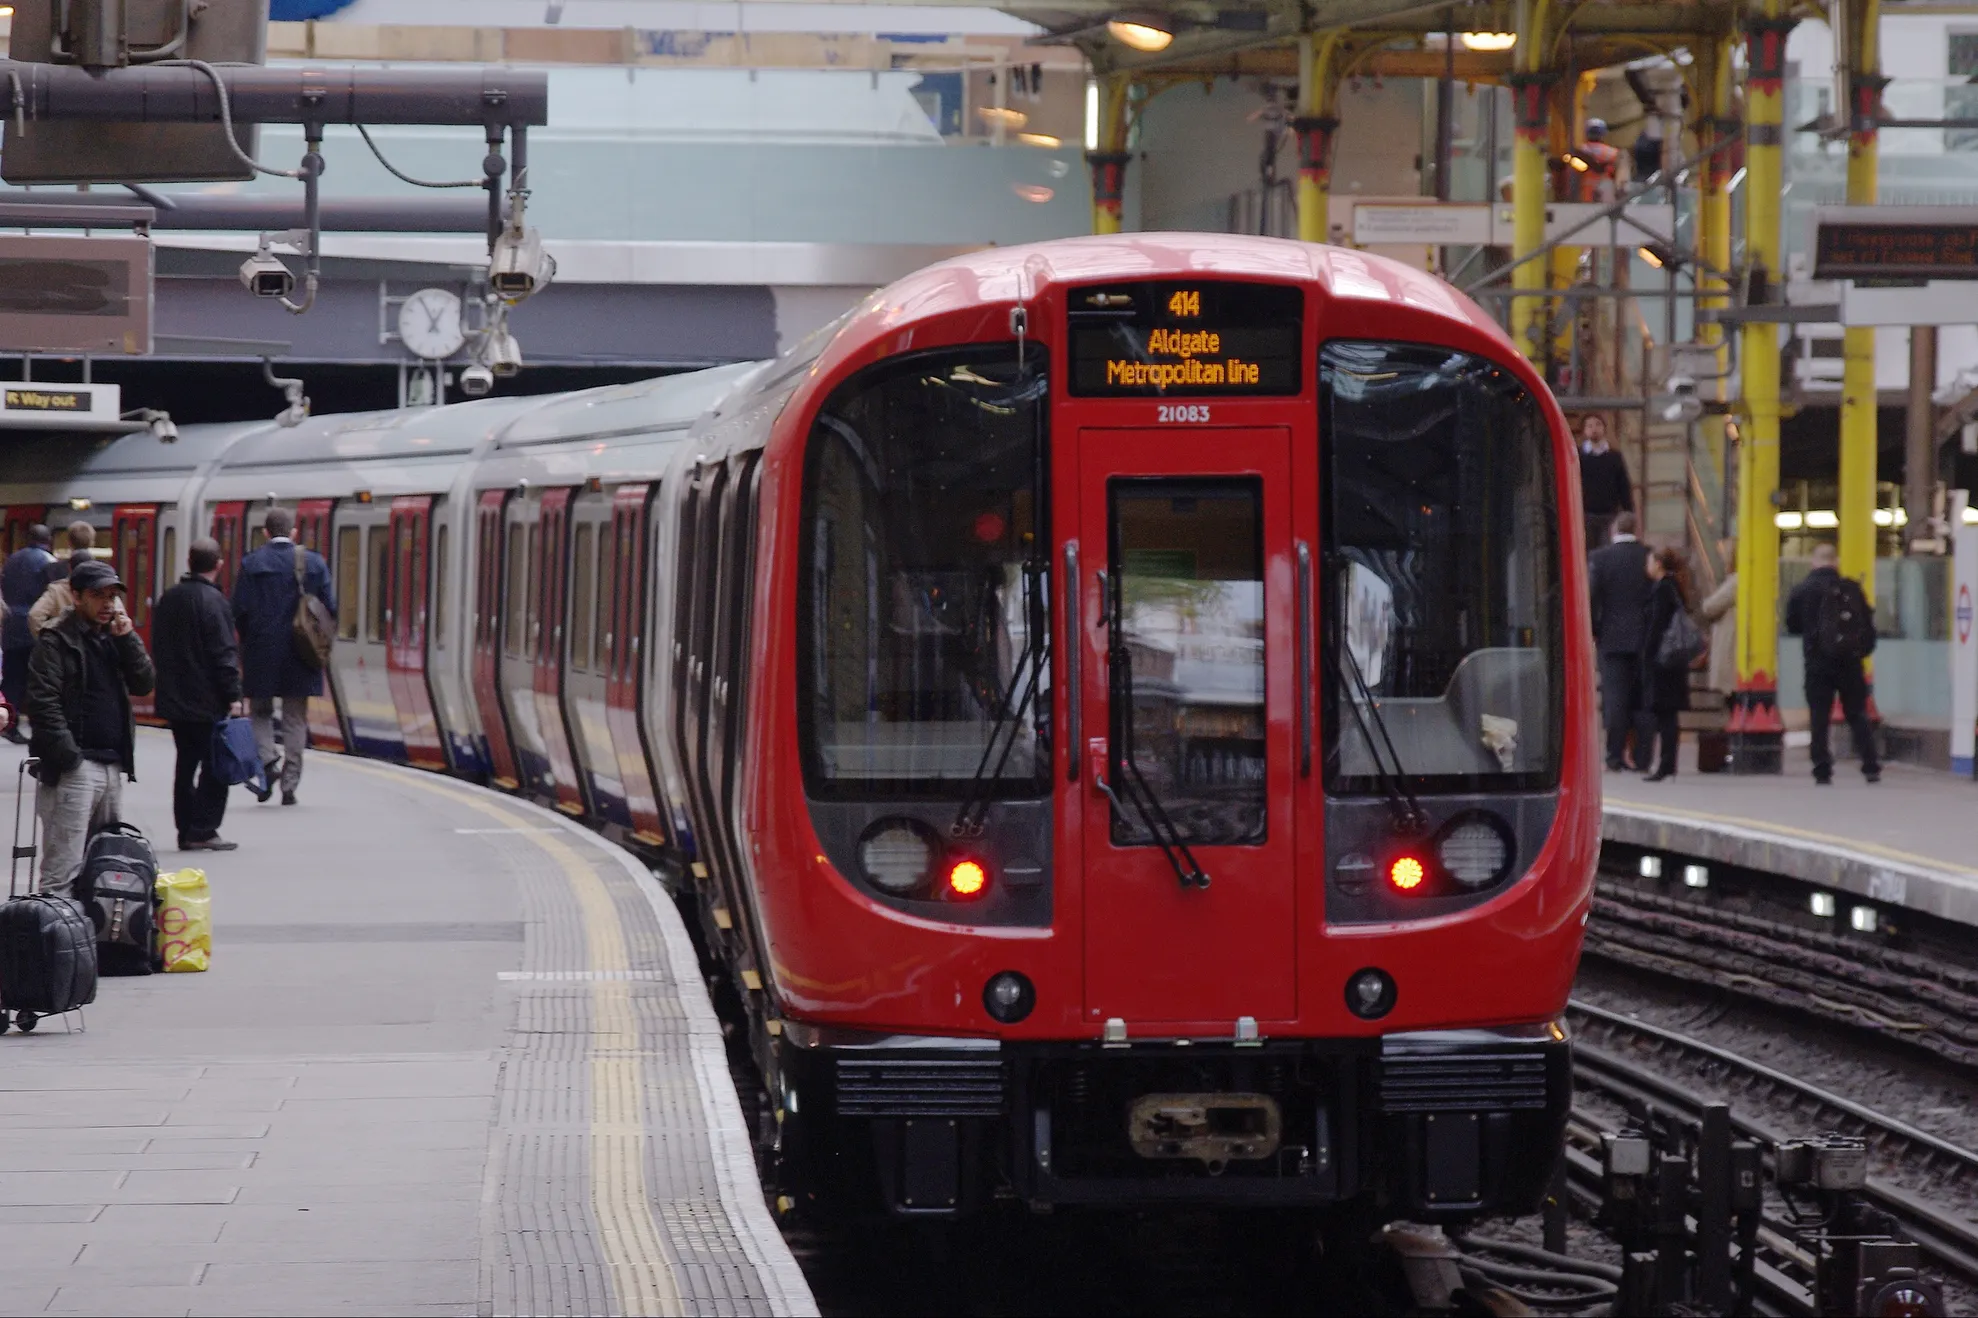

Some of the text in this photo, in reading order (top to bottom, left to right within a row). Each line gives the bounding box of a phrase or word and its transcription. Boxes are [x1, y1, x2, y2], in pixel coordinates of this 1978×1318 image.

[1168, 290, 1200, 316] 414
[1148, 329, 1220, 358] Aldgate
[1106, 359, 1259, 389] Metropolitan line
[21, 391, 77, 409] Way out
[1157, 405, 1210, 423] 21083
